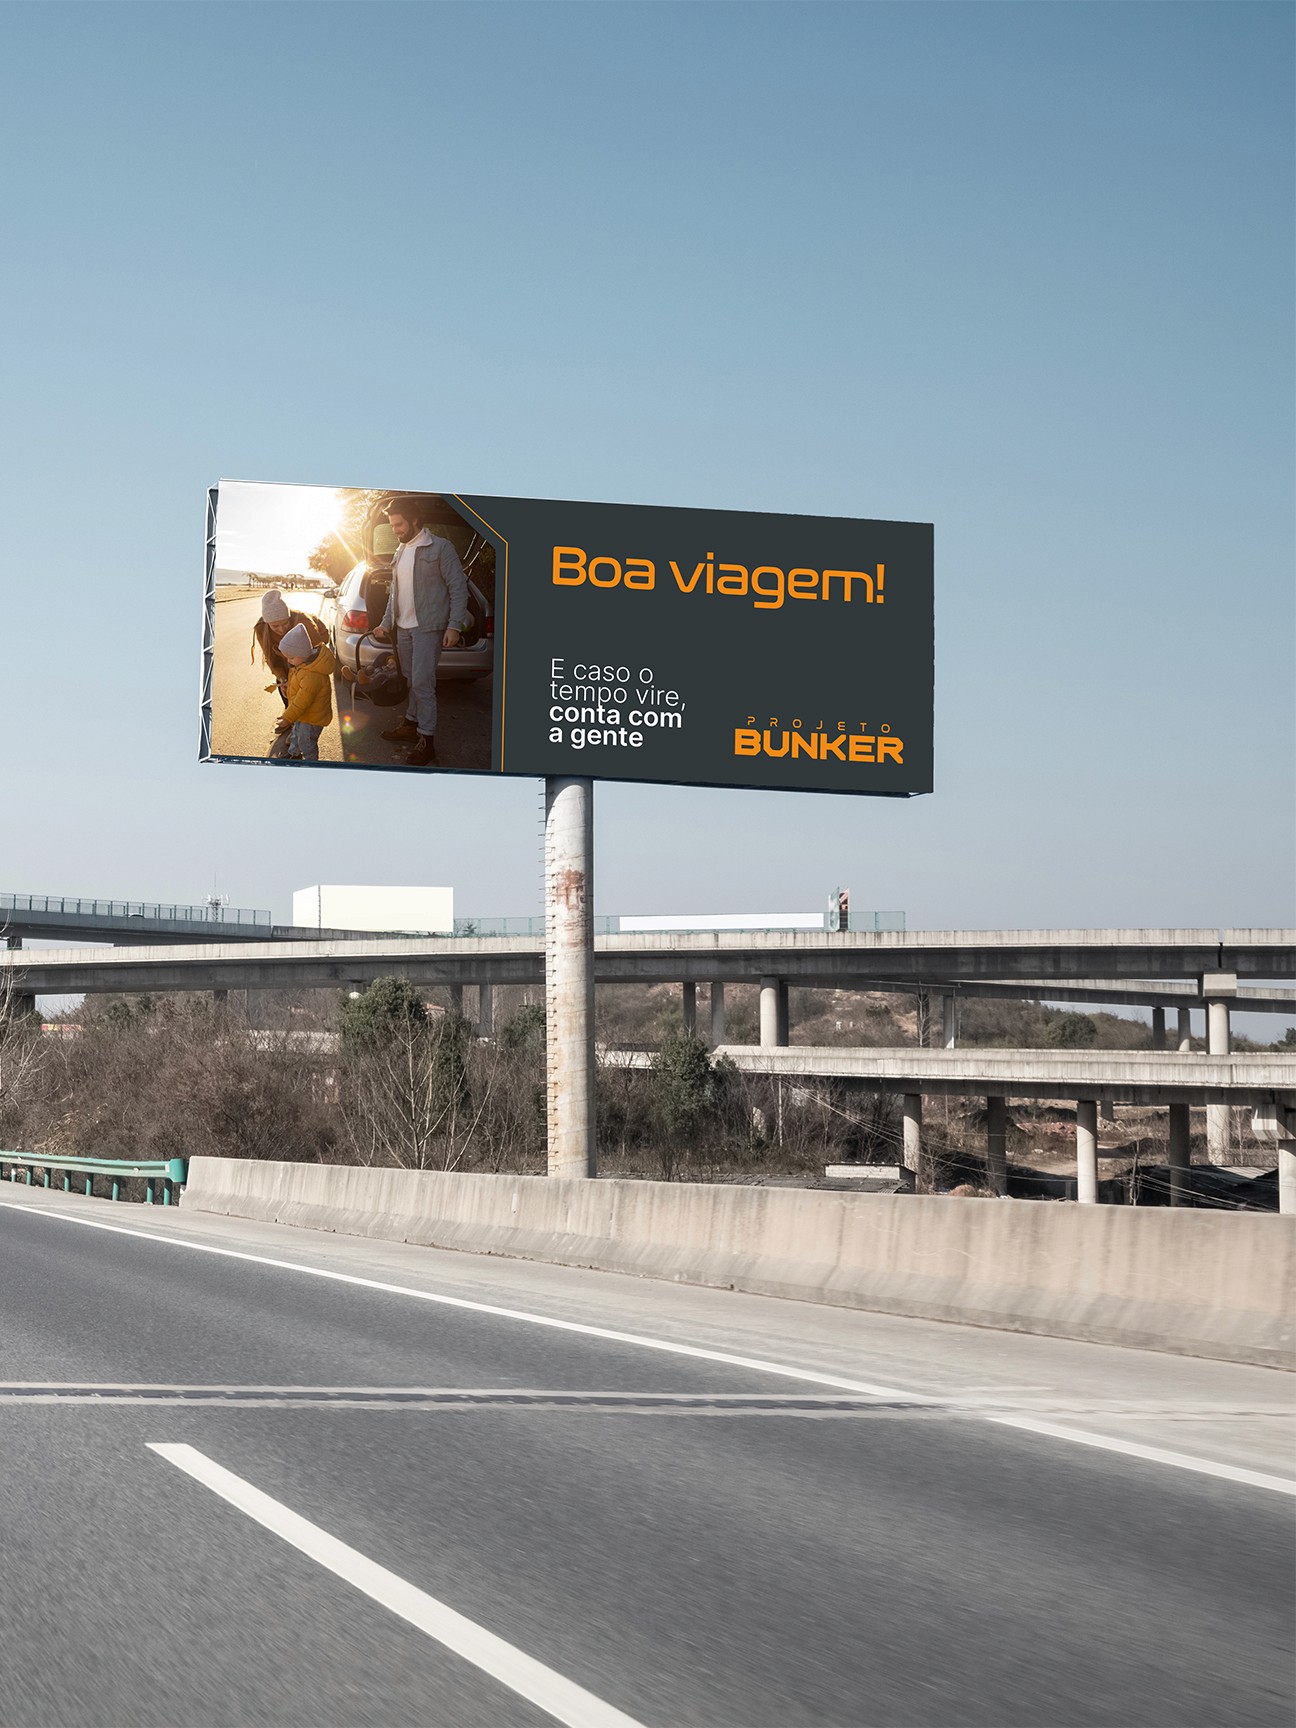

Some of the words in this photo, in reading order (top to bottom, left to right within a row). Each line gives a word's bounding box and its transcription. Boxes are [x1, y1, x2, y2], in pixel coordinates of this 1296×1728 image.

[553, 546, 655, 590] Boa
[669, 552, 884, 609] viagem!
[551, 658, 564, 679] E
[573, 664, 630, 683] caso
[639, 667, 654, 684] o
[550, 680, 628, 707] tempo
[635, 684, 686, 712] vire,
[549, 704, 621, 726] conta
[628, 708, 682, 729] com
[747, 715, 891, 734] PROJETO
[548, 726, 563, 743] a
[570, 727, 644, 750] gente
[734, 728, 904, 765] BUNKER
